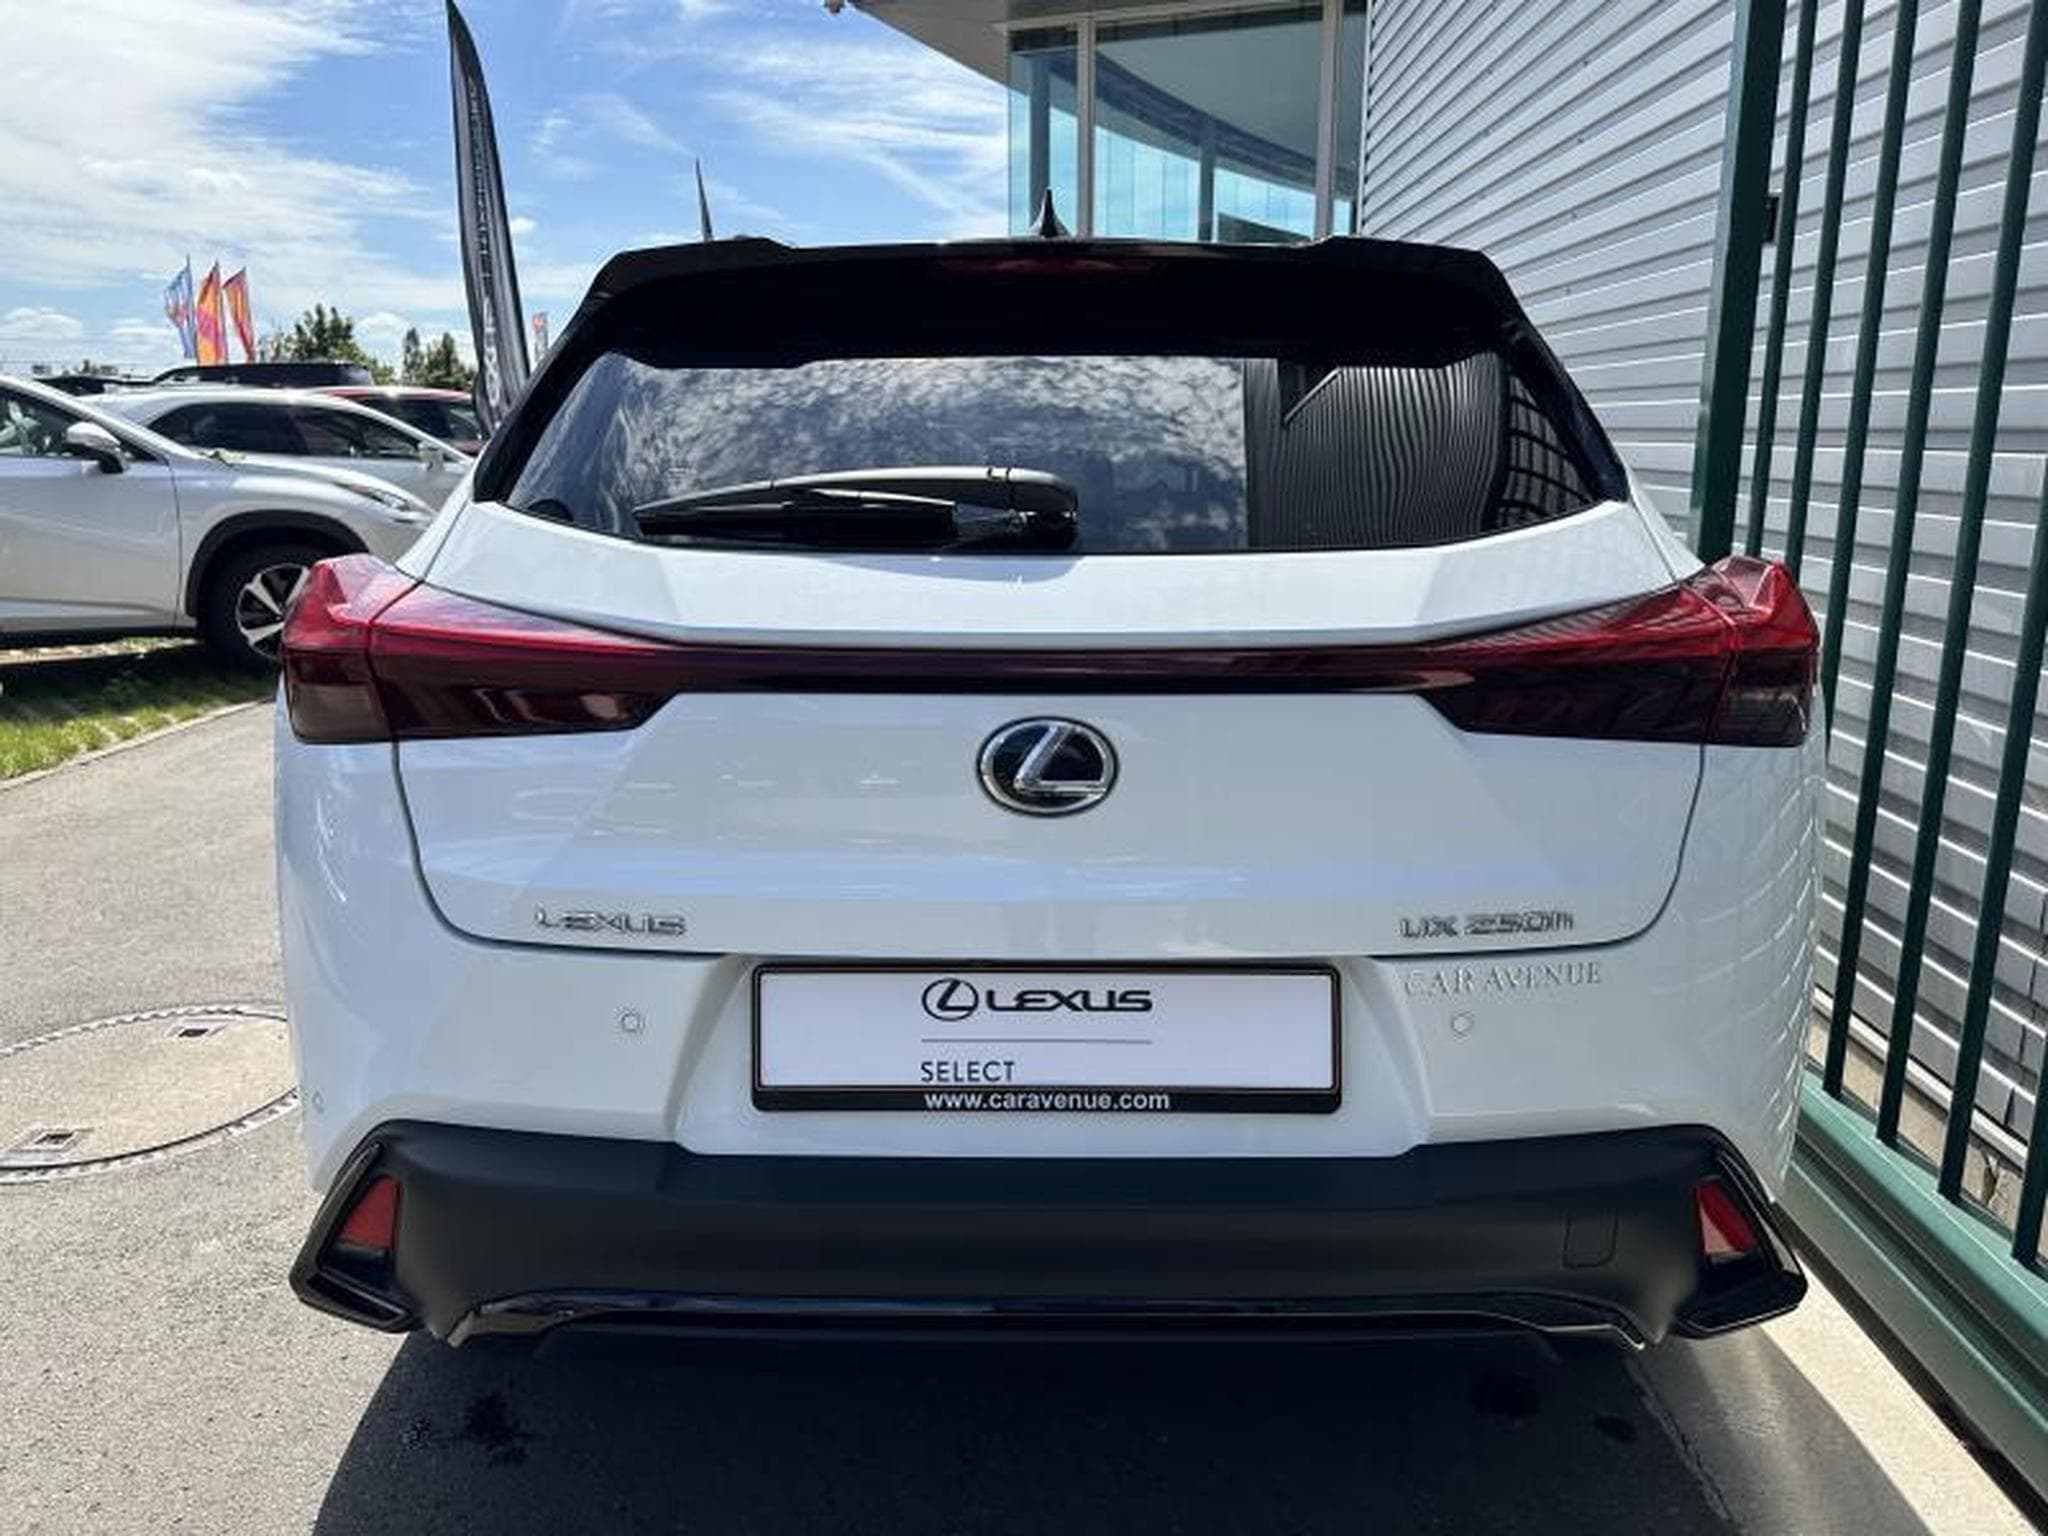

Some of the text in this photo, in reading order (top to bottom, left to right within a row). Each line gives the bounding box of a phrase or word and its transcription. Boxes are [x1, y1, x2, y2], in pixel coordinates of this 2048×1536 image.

[534, 907, 688, 937] LEXUS
[1401, 909, 1574, 938] UX 250h
[1404, 961, 1602, 997] CAR AVENUE
[986, 989, 1153, 1012] LEXUS
[920, 1061, 1015, 1083] SELECT
[924, 1091, 1171, 1110] www.caravenue.com
